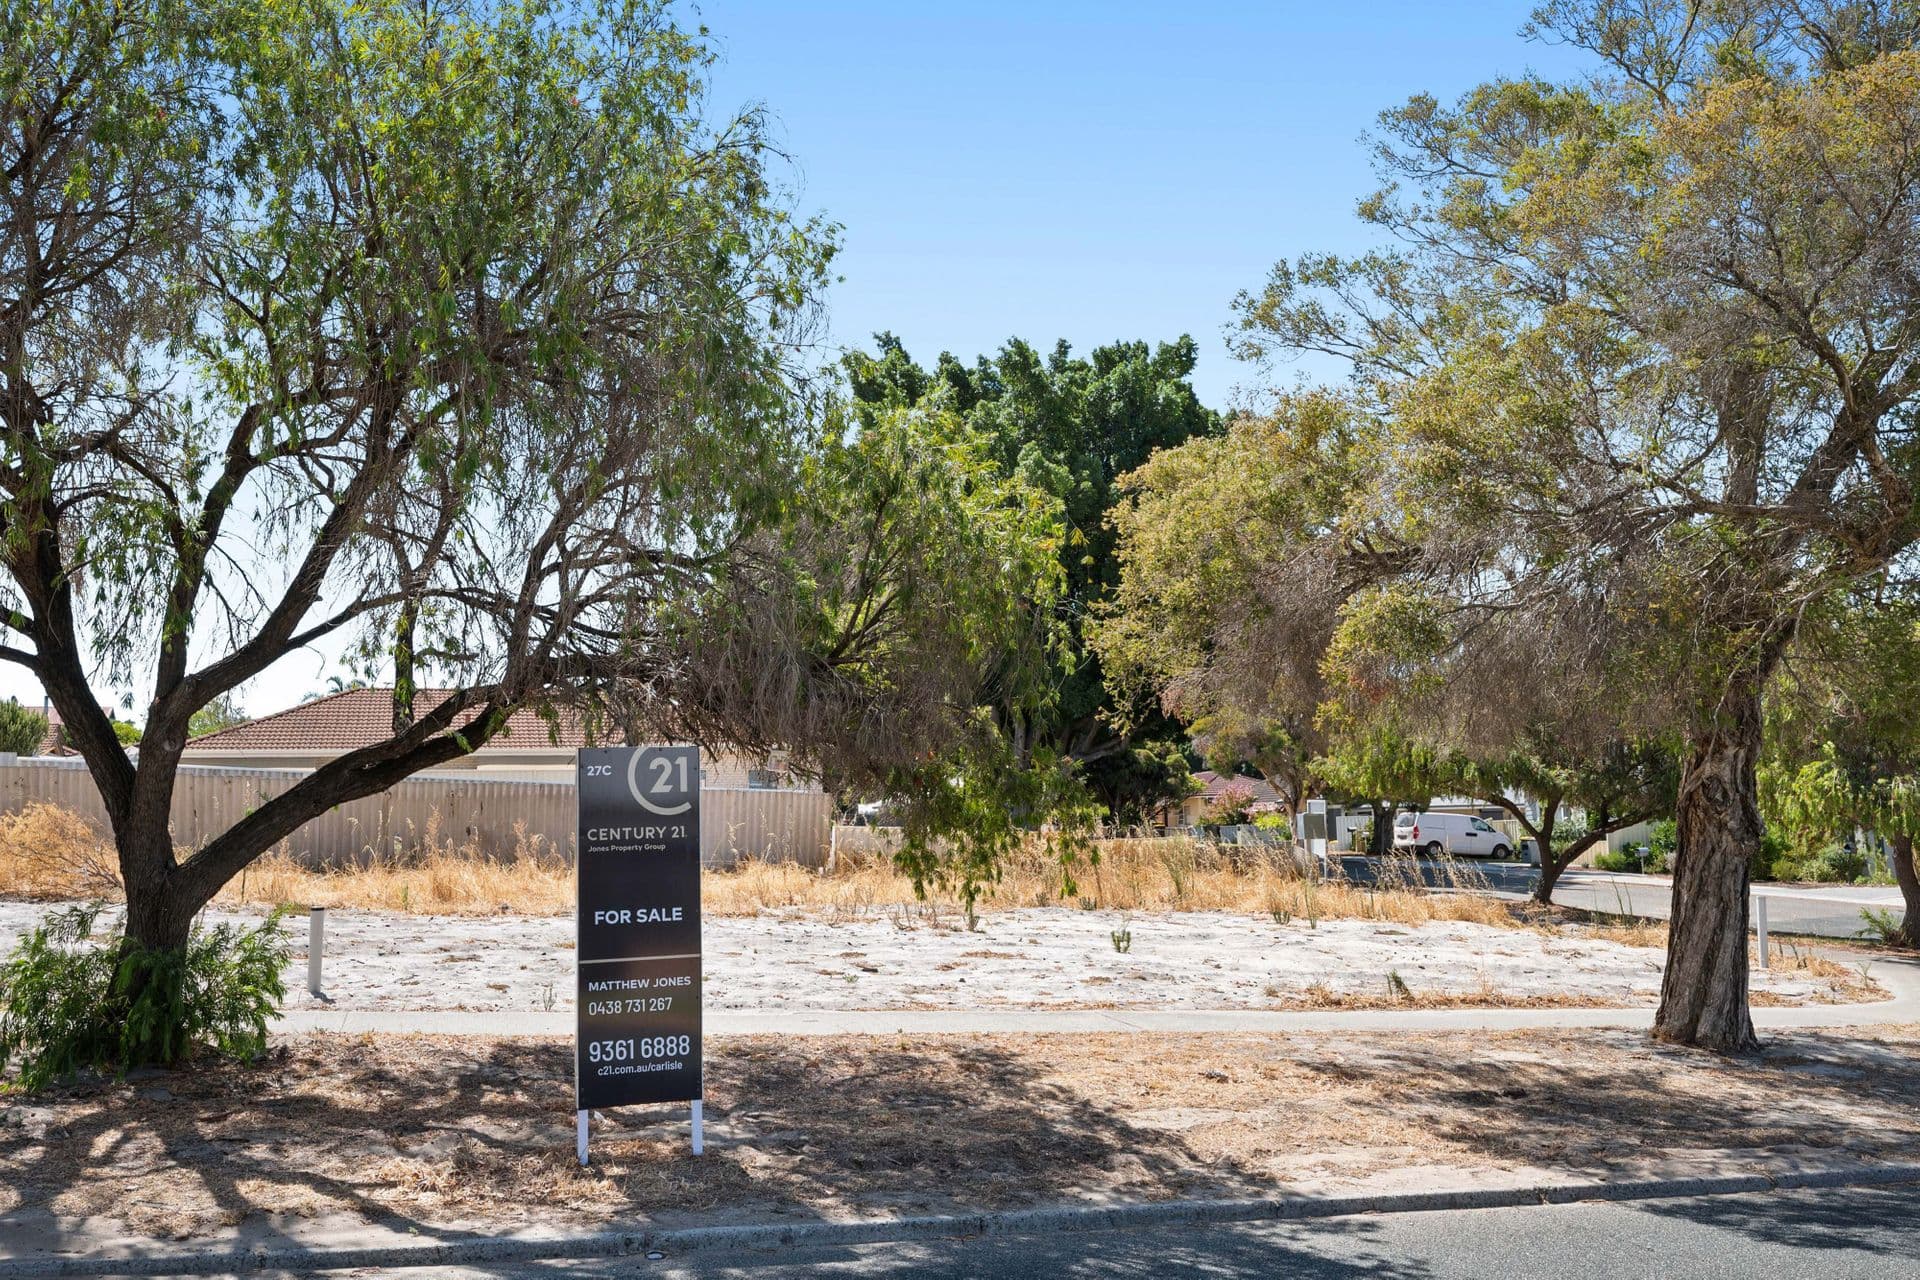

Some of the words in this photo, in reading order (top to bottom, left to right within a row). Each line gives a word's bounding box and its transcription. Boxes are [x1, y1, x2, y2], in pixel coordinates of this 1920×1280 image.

[587, 765, 612, 776] 27C
[587, 826, 667, 841] CENTURY
[588, 845, 610, 853] Jones
[610, 844, 643, 852] Property
[644, 843, 666, 851] Group
[594, 910, 632, 925] FOR
[636, 907, 682, 923] SALE
[588, 979, 650, 992] MATTHEW
[653, 976, 692, 988] JONES
[588, 1000, 622, 1016] 0438
[625, 999, 646, 1013] 731
[649, 997, 673, 1012] 267
[589, 1039, 635, 1063] 9361
[640, 1034, 690, 1059] 6888
[597, 1060, 683, 1076] c21.com.au/carlisle
